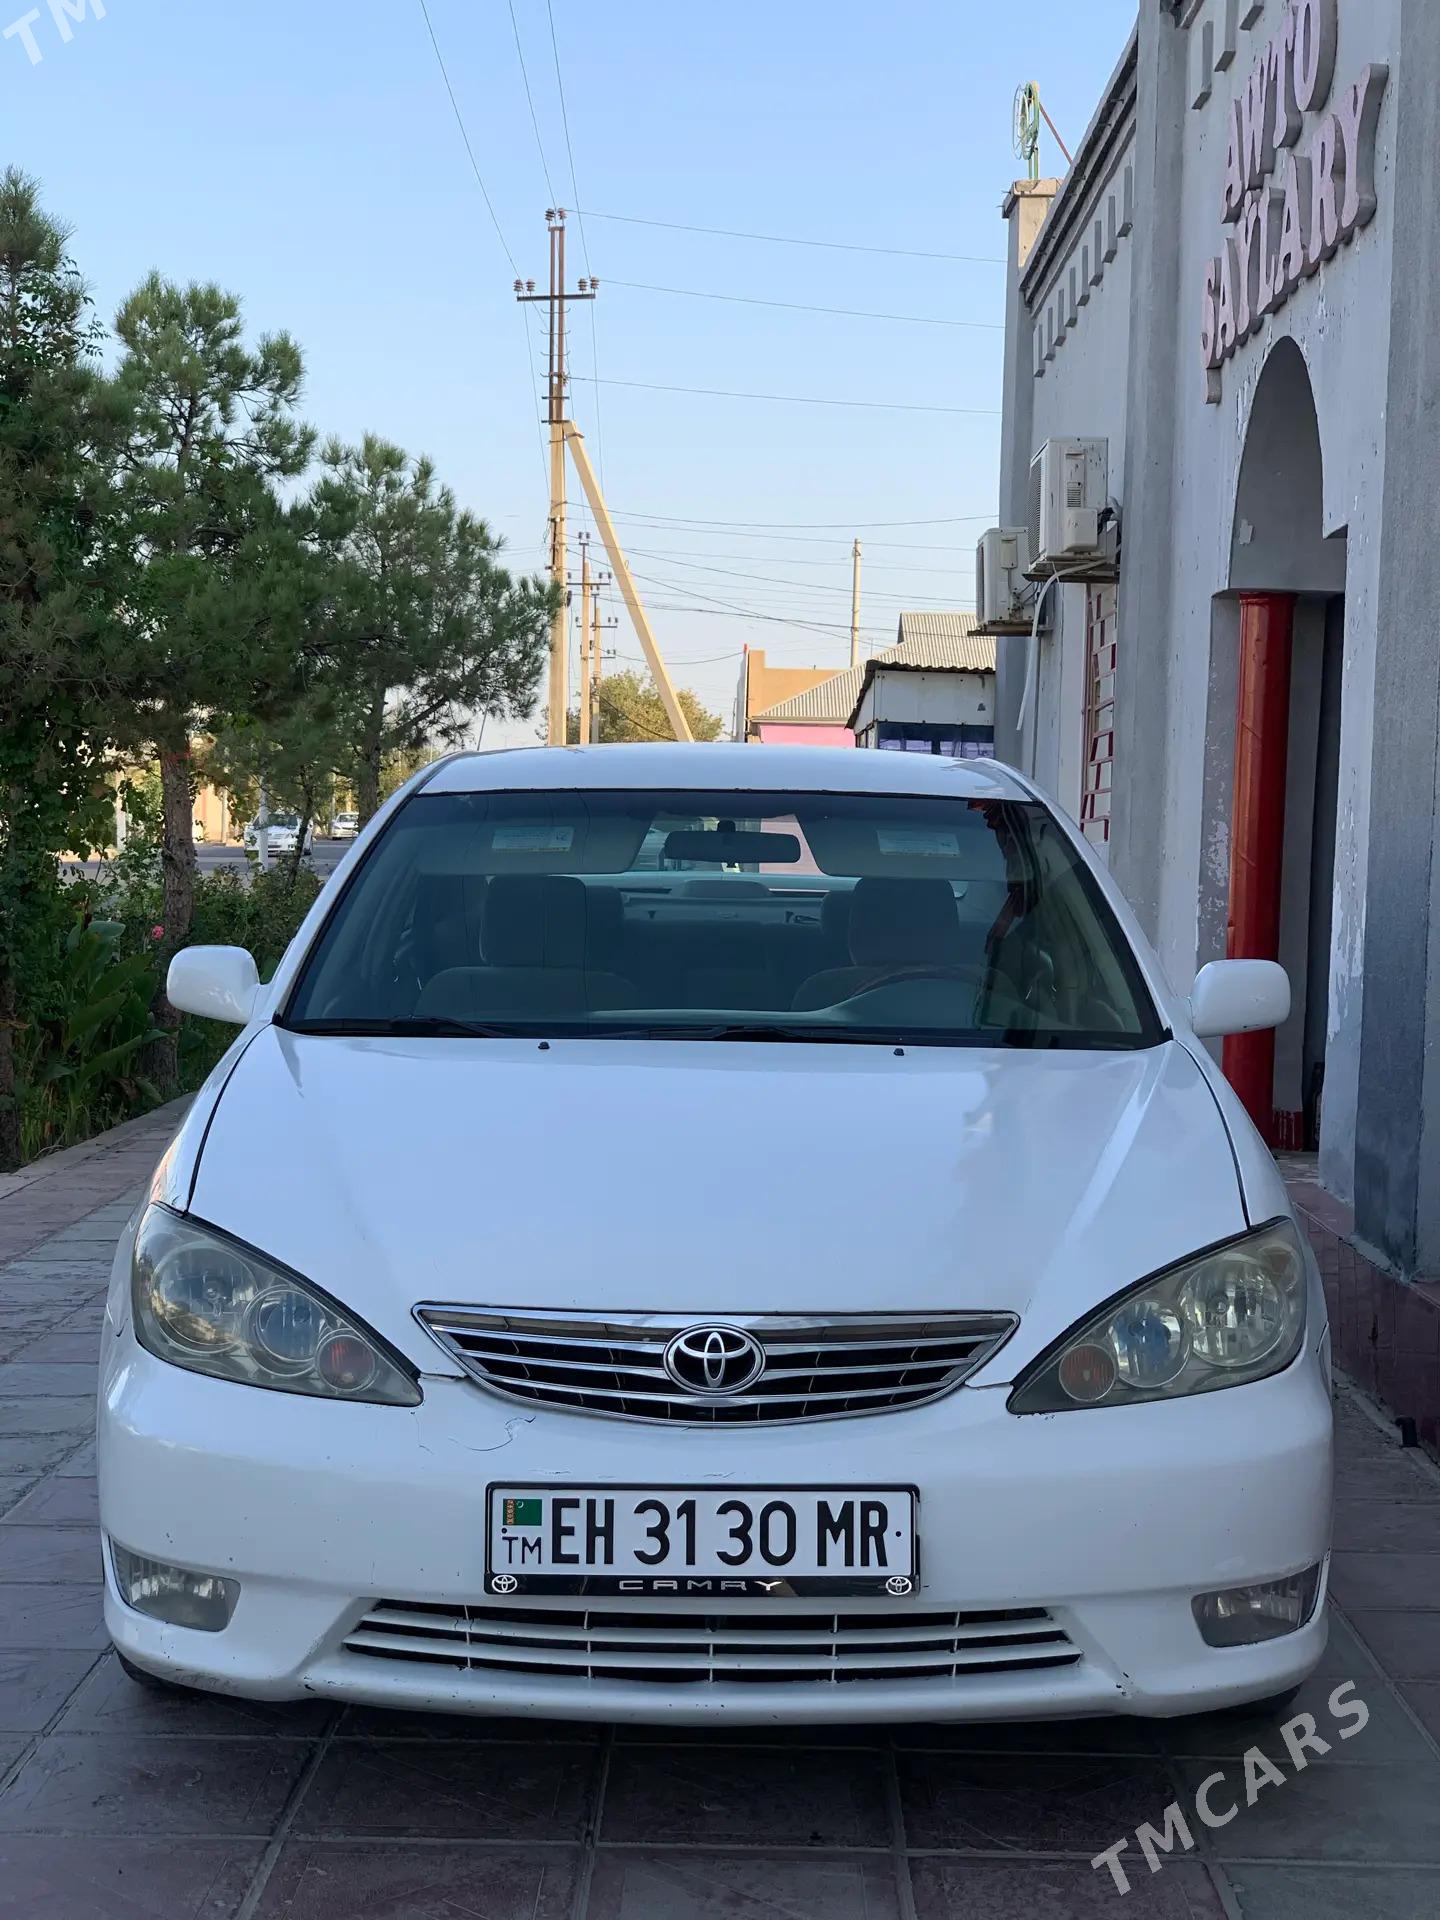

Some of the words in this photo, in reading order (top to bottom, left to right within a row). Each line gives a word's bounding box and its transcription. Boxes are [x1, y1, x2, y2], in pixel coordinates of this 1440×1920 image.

[1220, 0, 1332, 223] AWTO
[502, 1536, 542, 1565] TM
[551, 1497, 614, 1565] EH
[633, 1499, 696, 1566] 31
[716, 1499, 797, 1567] 30
[816, 1500, 889, 1568] MR
[618, 1579, 783, 1592] CAMRY
